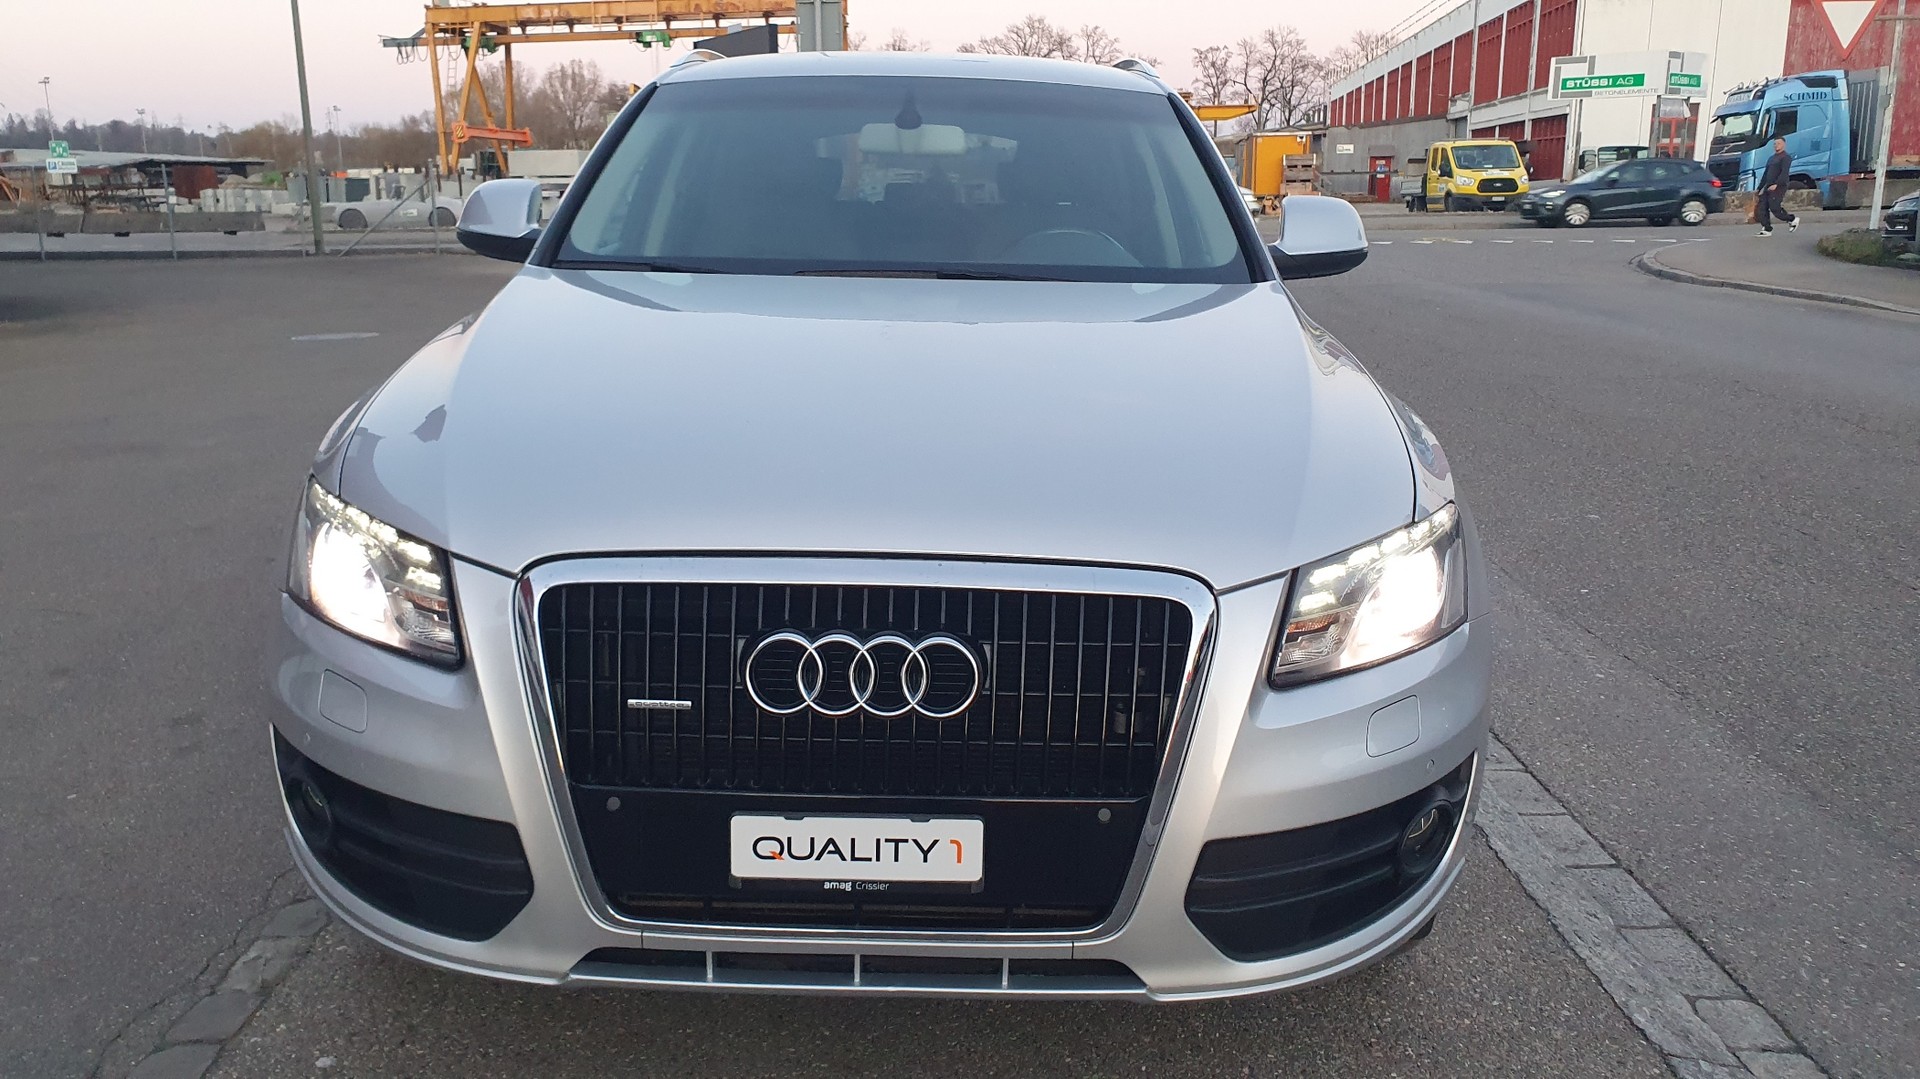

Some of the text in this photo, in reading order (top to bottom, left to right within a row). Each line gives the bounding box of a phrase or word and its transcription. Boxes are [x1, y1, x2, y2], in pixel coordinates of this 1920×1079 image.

[1566, 76, 1634, 89] STÜSSI AG
[1594, 87, 1659, 96] BETONELEMENTE
[1783, 91, 1828, 101] SCHMID
[752, 836, 963, 864] QUALITY 1
[823, 881, 890, 891] amag Crissier
